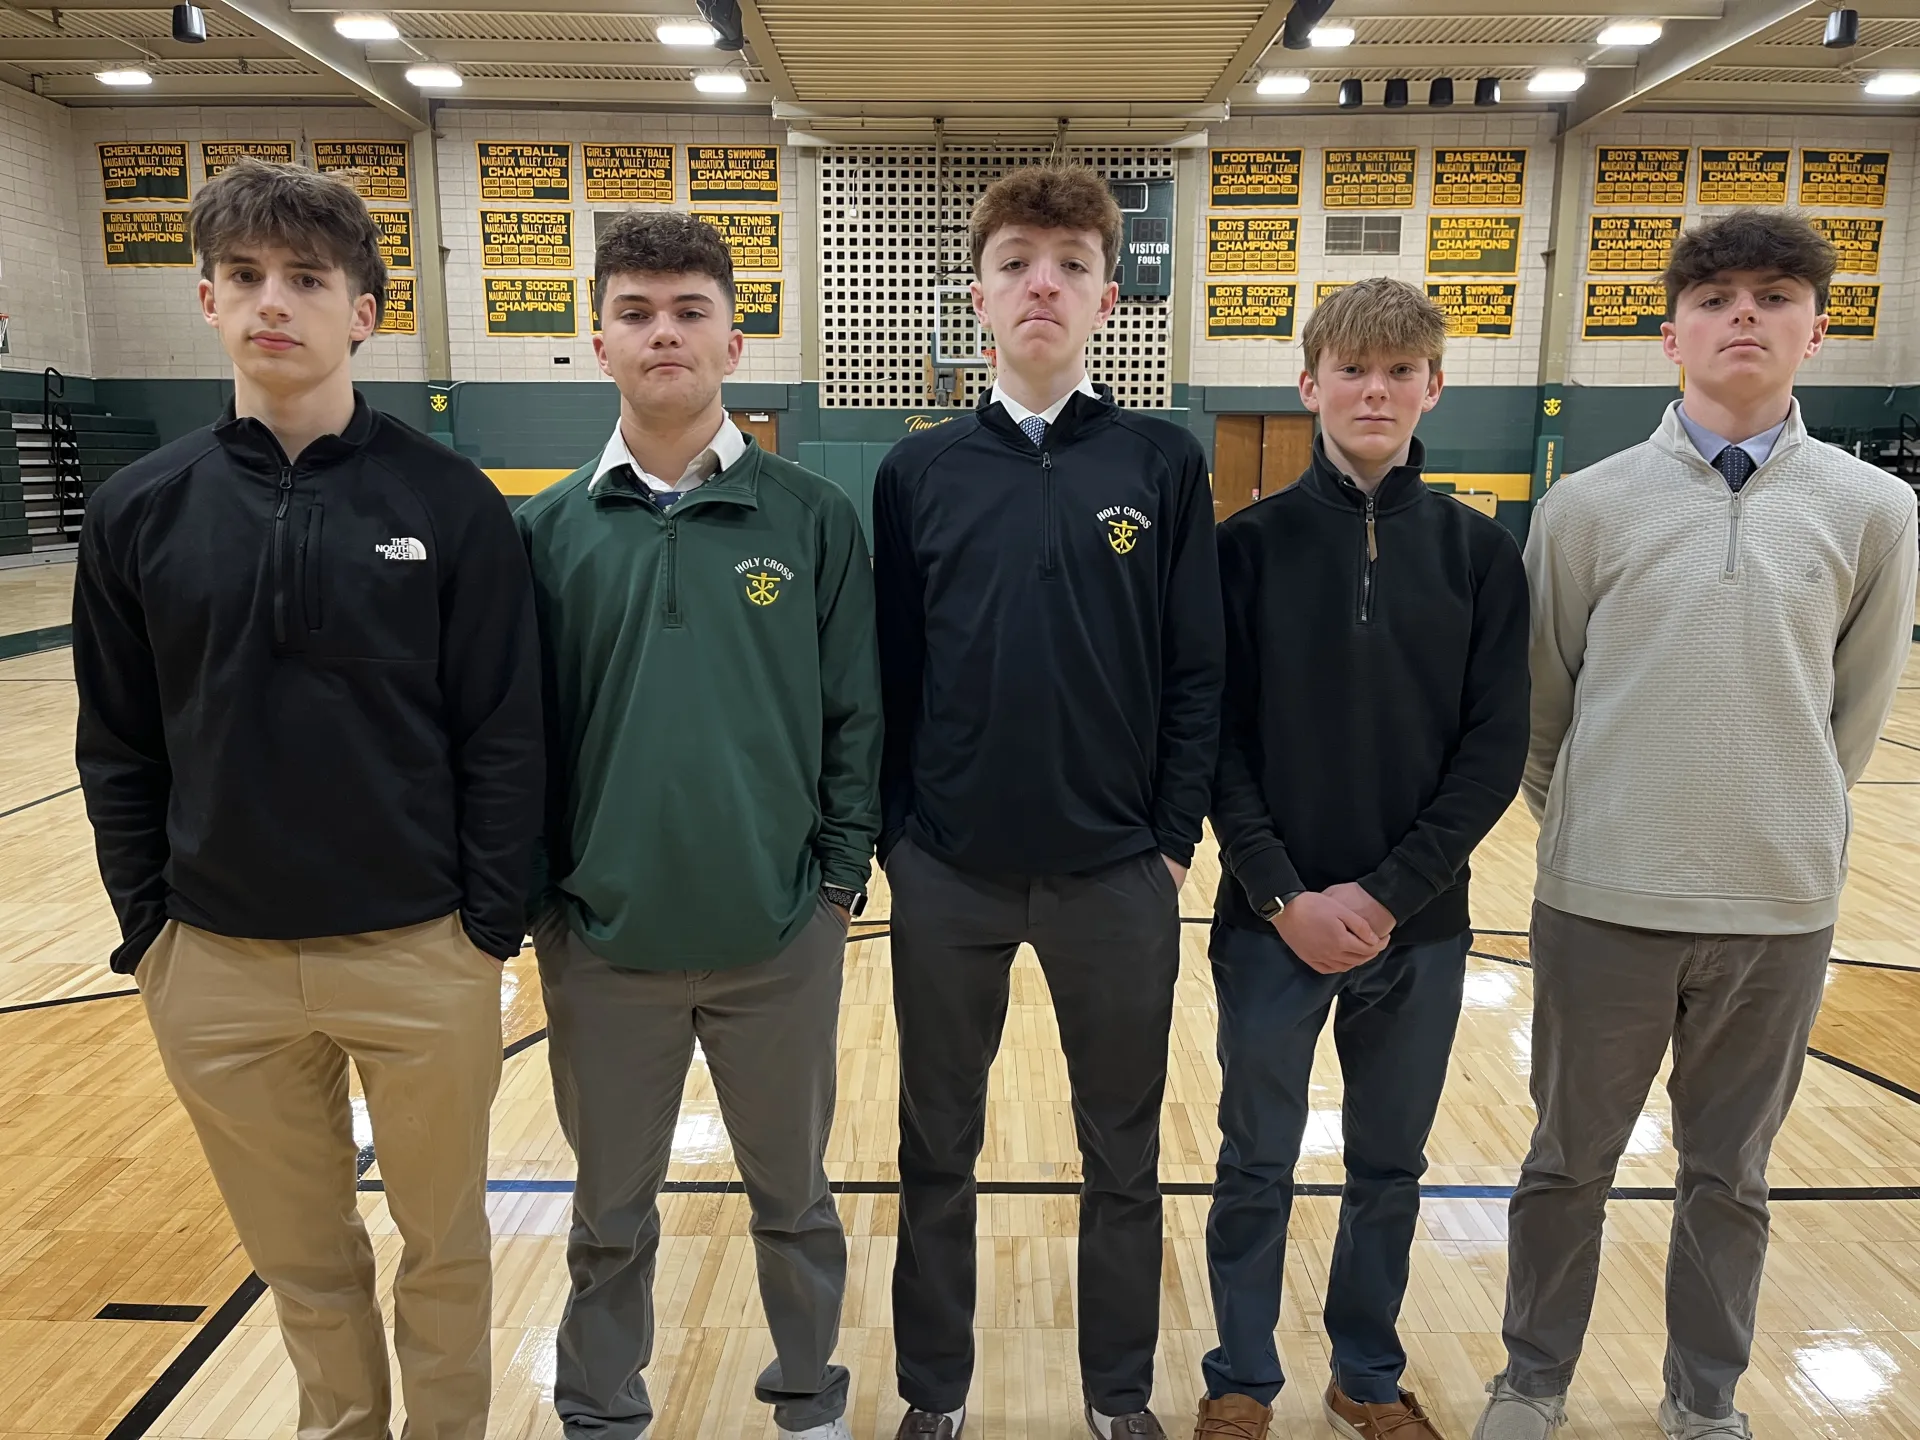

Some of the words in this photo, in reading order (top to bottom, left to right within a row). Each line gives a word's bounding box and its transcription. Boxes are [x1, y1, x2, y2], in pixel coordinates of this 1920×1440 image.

[104, 146, 181, 157] CHEERLEADING
[207, 145, 287, 155] CHEERLEADING
[318, 145, 341, 155] GIRLS
[346, 145, 402, 155] BASKETBALL
[488, 146, 558, 156] SOFTBALL
[587, 147, 611, 157] GIRLS
[615, 148, 670, 158] VOLLEYBALL
[700, 149, 724, 159] GIRLS
[727, 149, 766, 159] SWIMMING
[318, 155, 352, 165] NAUGATUCK
[355, 156, 378, 165] VALLEY
[381, 156, 404, 166] LEAGUE
[1222, 153, 1290, 163] FOOTBALL
[1330, 153, 1351, 162] BOYS
[1356, 151, 1411, 162] BASKETBALL
[1445, 152, 1515, 162] BASEBALL
[1608, 151, 1637, 160] BOYS
[1641, 151, 1679, 160] TENNIS
[1728, 152, 1763, 161] GOLF
[1828, 153, 1864, 162] GOLF
[103, 156, 135, 167] NAUGATUCK
[138, 156, 160, 166] VALLEY
[162, 156, 184, 166] LEAGUE
[481, 157, 515, 167] NAUGATUCK
[519, 157, 541, 166] VALLEY
[545, 157, 567, 167] LEAGUE
[587, 158, 620, 167] NAUGATUCK
[623, 158, 645, 168] VALLEY
[648, 159, 671, 168] LEAGUE
[691, 160, 725, 169] NAUGATUCK
[728, 160, 750, 169] VALLEY
[753, 160, 775, 169] LEAGUE
[489, 167, 561, 177] CHAMPIONS
[1214, 164, 1247, 174] NAUGATUCK
[1251, 164, 1272, 173] VALLEY
[1275, 164, 1299, 174] LEAGUE
[1365, 163, 1387, 172] VALLEY
[1390, 162, 1413, 172] LEAGUE
[109, 167, 180, 178] CHAMPIONS
[593, 168, 665, 178] CHAMPIONS
[698, 170, 770, 180] CHAMPIONS
[1605, 172, 1678, 181] CHAMPIONS
[1709, 172, 1779, 181] CHAMPIONS
[1220, 175, 1292, 184] CHAMPIONS
[1333, 173, 1406, 184] CHAMPIONS
[1443, 173, 1516, 183] CHAMPIONS
[1810, 173, 1878, 183] CHAMPIONS
[110, 214, 131, 223] GIRLS
[133, 213, 157, 222] INDOOR
[160, 213, 183, 221] TRACK
[487, 213, 518, 223] GIRLS
[522, 213, 565, 224] SOCCER
[733, 216, 771, 226] TENNIS
[107, 223, 139, 233] NAUGATUCK
[141, 223, 162, 232] VALLEY
[1218, 221, 1244, 231] BOYS
[1248, 221, 1290, 230] SOCCER
[1441, 219, 1509, 228] BASEBALL
[1601, 219, 1630, 229] BOYS
[1634, 219, 1673, 229] TENNIS
[384, 225, 407, 234] LEAGUE
[485, 224, 518, 233] NAUGATUCK
[521, 224, 542, 234] VALLEY
[545, 224, 567, 234] LEAGUE
[730, 226, 751, 235] VALLEY
[753, 226, 776, 235] LEAGUE
[113, 233, 183, 242] CHAMPIONS
[491, 234, 563, 244] CHAMPIONS
[1211, 231, 1244, 240] NAUGATUCK
[1247, 231, 1269, 240] VALLEY
[1272, 231, 1295, 240] LEAGUE
[1129, 243, 1170, 255] VISITOR
[1217, 241, 1288, 251] CHAMPIONS
[1437, 240, 1510, 249] CHAMPIONS
[1598, 240, 1671, 249] CHAMPIONS
[394, 247, 408, 255] 2014
[1137, 256, 1162, 265] FOULS
[492, 281, 522, 290] GIRLS
[526, 281, 568, 291] SOCCER
[735, 284, 772, 293] TENNIS
[1439, 286, 1461, 295] BOYS
[1465, 286, 1504, 295] SWIMMING
[1596, 286, 1625, 295] BOYS
[1629, 286, 1666, 295] TENNIS
[389, 291, 411, 300] LEAGUE
[489, 291, 521, 301] NAUGATUCK
[525, 292, 546, 301] VALLEY
[549, 292, 572, 302] LEAGUE
[1216, 287, 1243, 297] BOYS
[1247, 287, 1288, 296] SOCCER
[756, 294, 777, 303] LEAGUE
[1210, 297, 1243, 306] NAUGATUCK
[1246, 297, 1268, 306] VALLEY
[1270, 297, 1293, 306] LEAGUE
[1466, 296, 1488, 304] VALLEY
[1490, 295, 1513, 304] LEAGUE
[496, 302, 565, 312] CHAMPIONS
[1216, 307, 1287, 316] CHAMPIONS
[1594, 306, 1666, 315] CHAMPIONS
[1096, 505, 1121, 522] HOLY
[1123, 506, 1152, 529] CROSS
[390, 537, 409, 545] THE
[375, 544, 409, 552] NORTH
[385, 552, 409, 560] FACE
[734, 557, 760, 574] HOLY
[763, 557, 794, 581] CROSS
